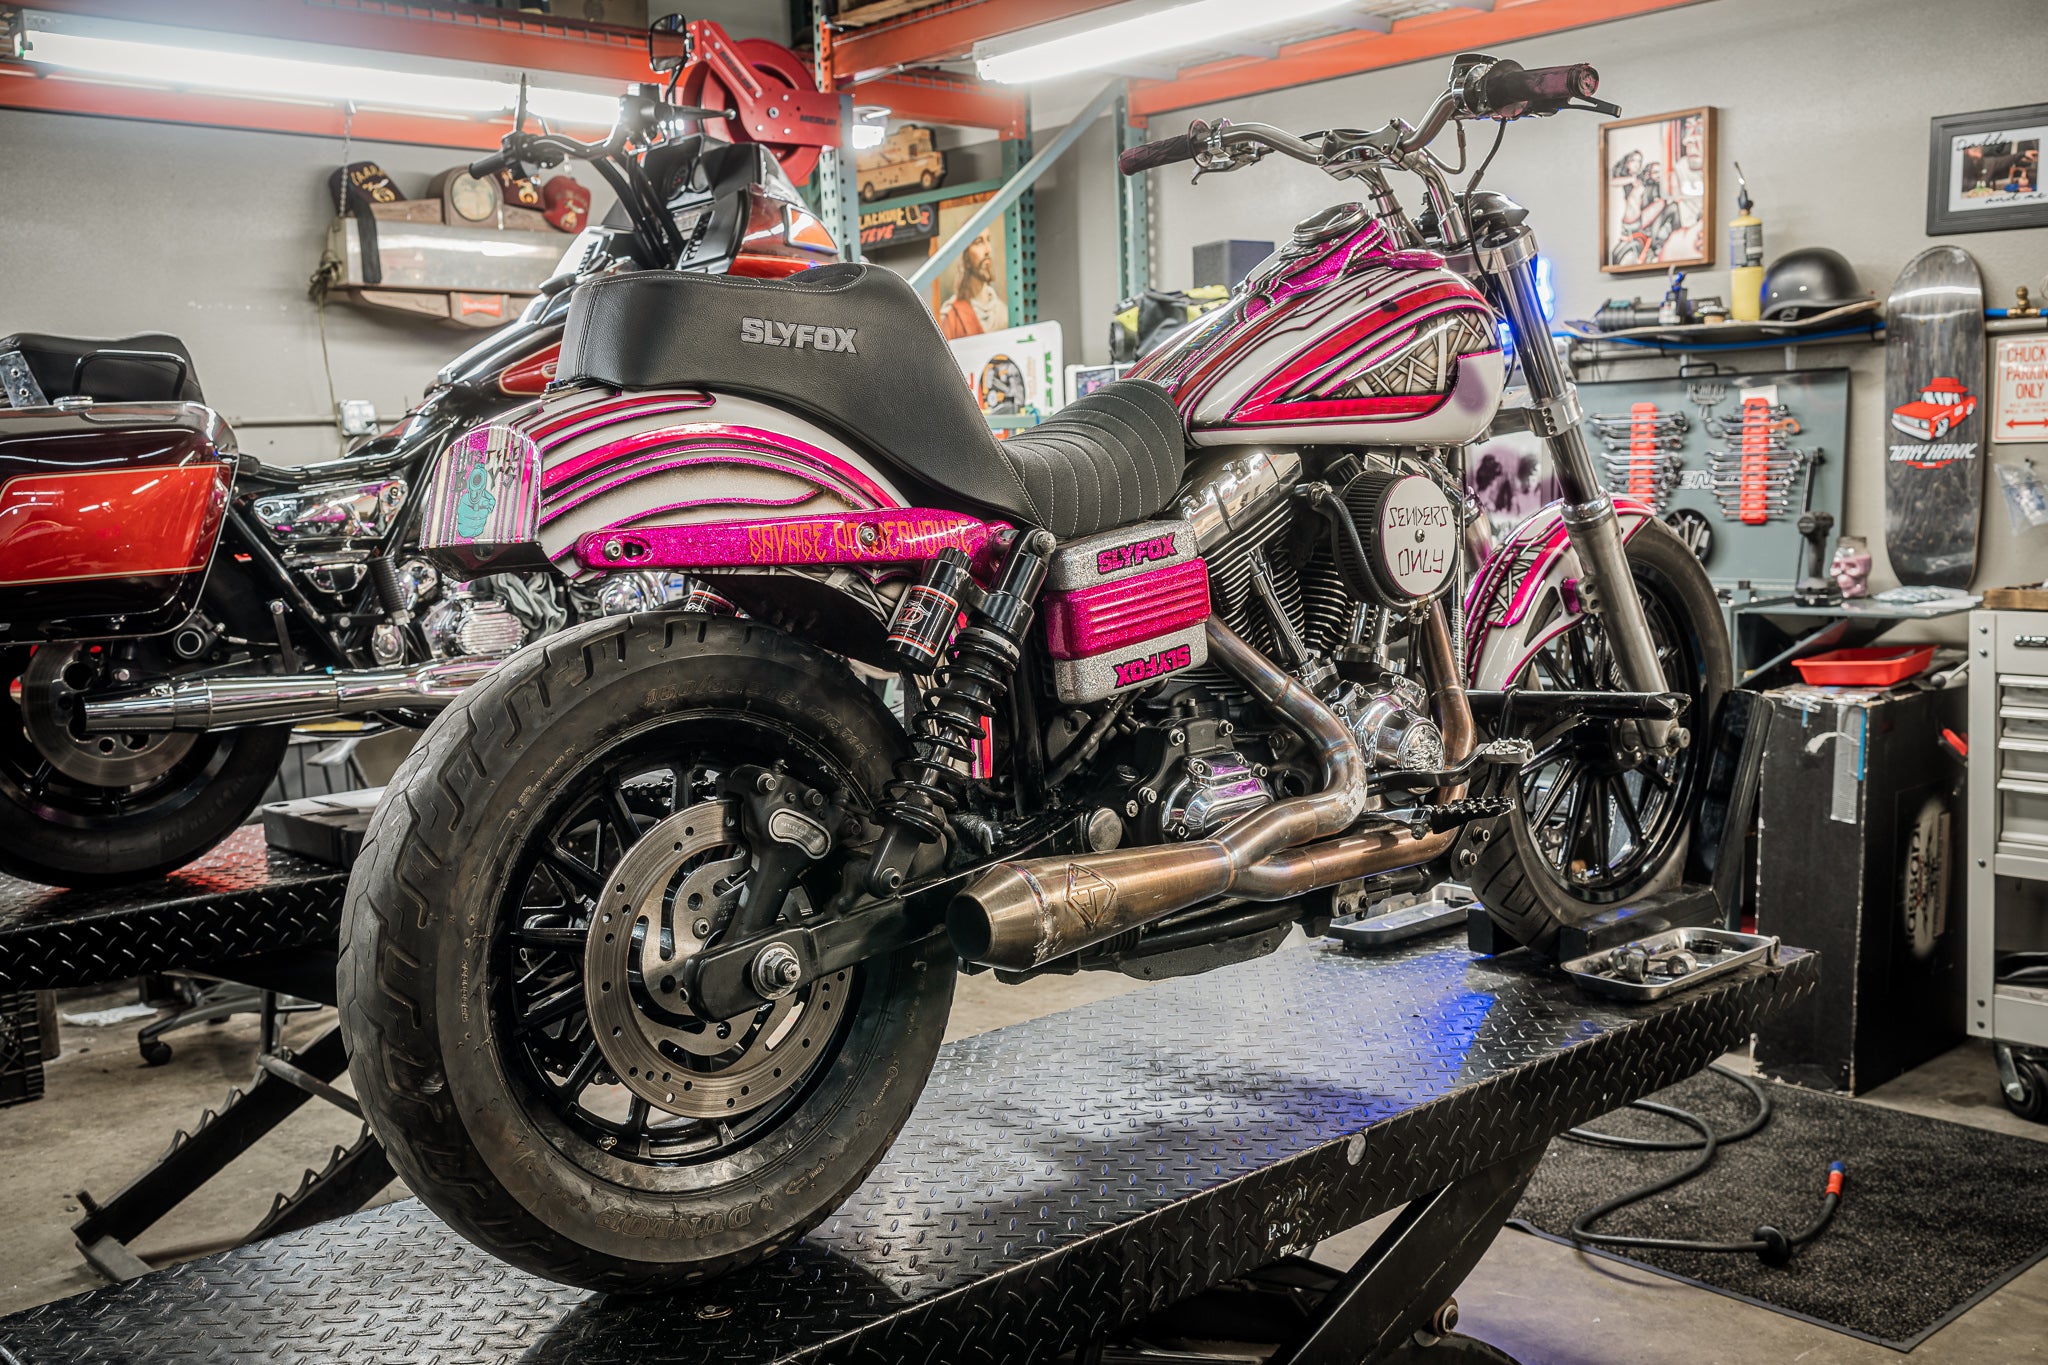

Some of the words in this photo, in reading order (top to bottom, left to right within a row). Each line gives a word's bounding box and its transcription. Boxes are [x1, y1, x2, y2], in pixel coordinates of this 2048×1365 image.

[740, 316, 858, 354] SLYFOX
[2005, 364, 2048, 381] PARKIN
[2015, 382, 2044, 400] ONLY
[1388, 505, 1449, 530] SENDERS
[748, 523, 827, 564] SAVAGE
[1097, 532, 1178, 575] SLYFOX
[1397, 547, 1444, 577] ONLY
[1112, 643, 1192, 689] SLYFOX
[595, 1202, 753, 1241] DUNLOP
